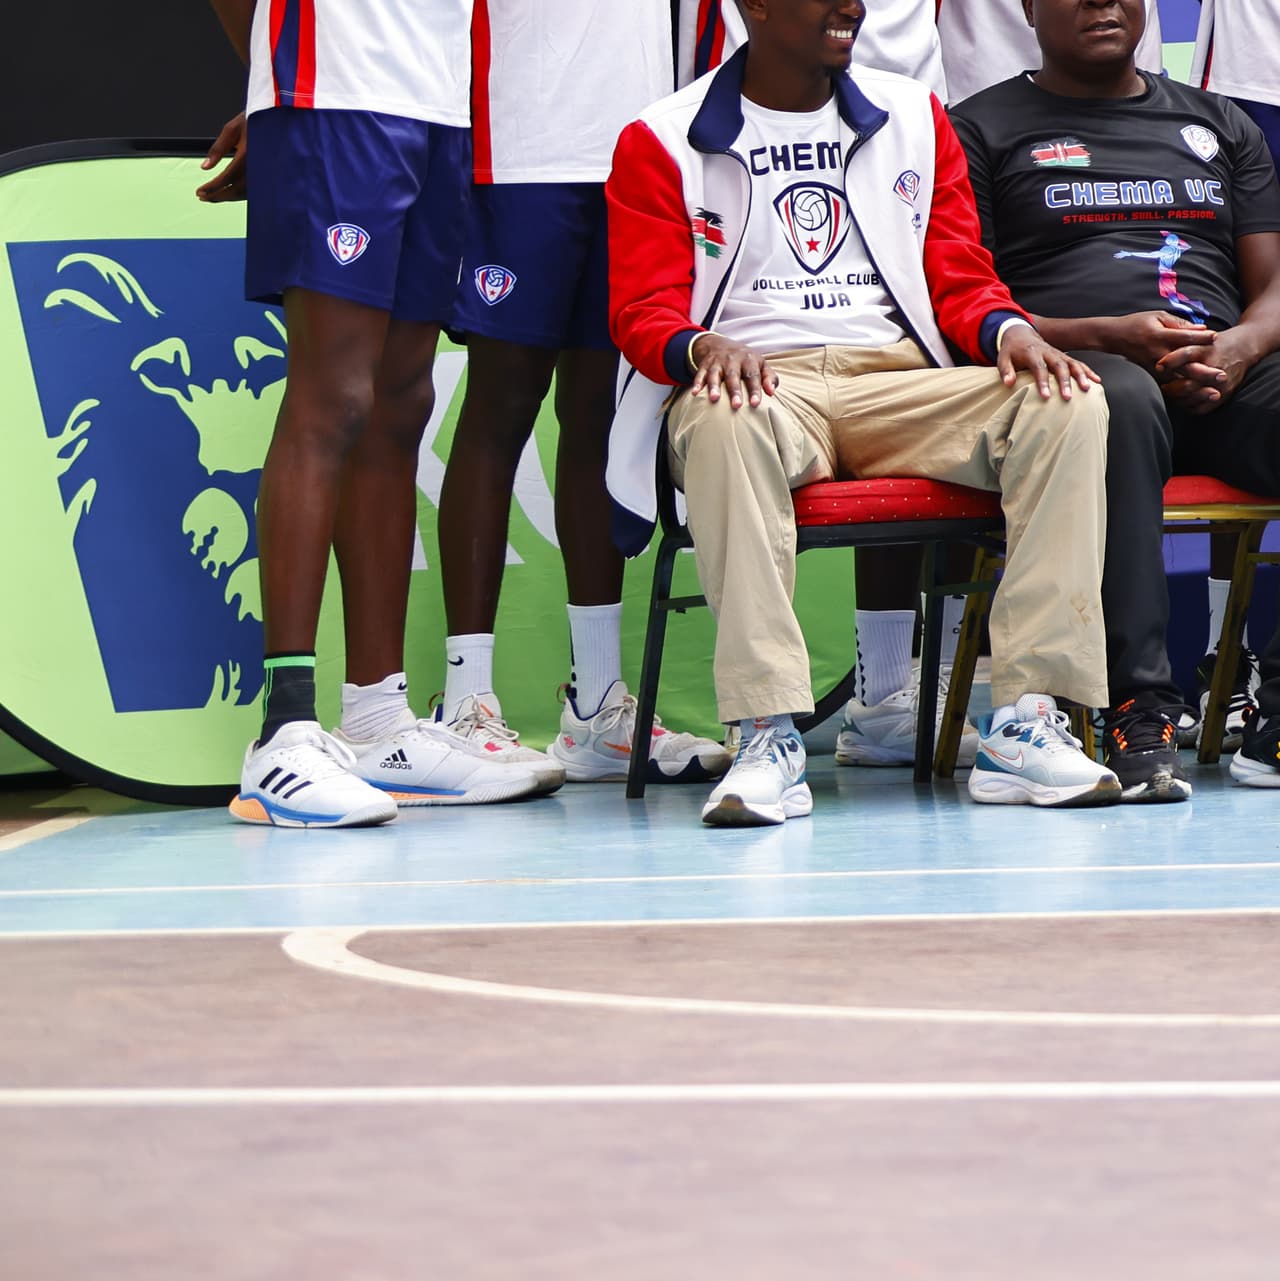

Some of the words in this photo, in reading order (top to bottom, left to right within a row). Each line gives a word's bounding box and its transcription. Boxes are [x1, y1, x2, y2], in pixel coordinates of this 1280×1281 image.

[749, 139, 842, 177] CHEM
[1045, 179, 1175, 209] CHEMA
[1184, 178, 1225, 206] VC
[752, 275, 842, 292] VOLLEYBALL
[846, 273, 880, 286] CLUB
[799, 292, 852, 310] JUJA
[379, 761, 412, 770] adidas
